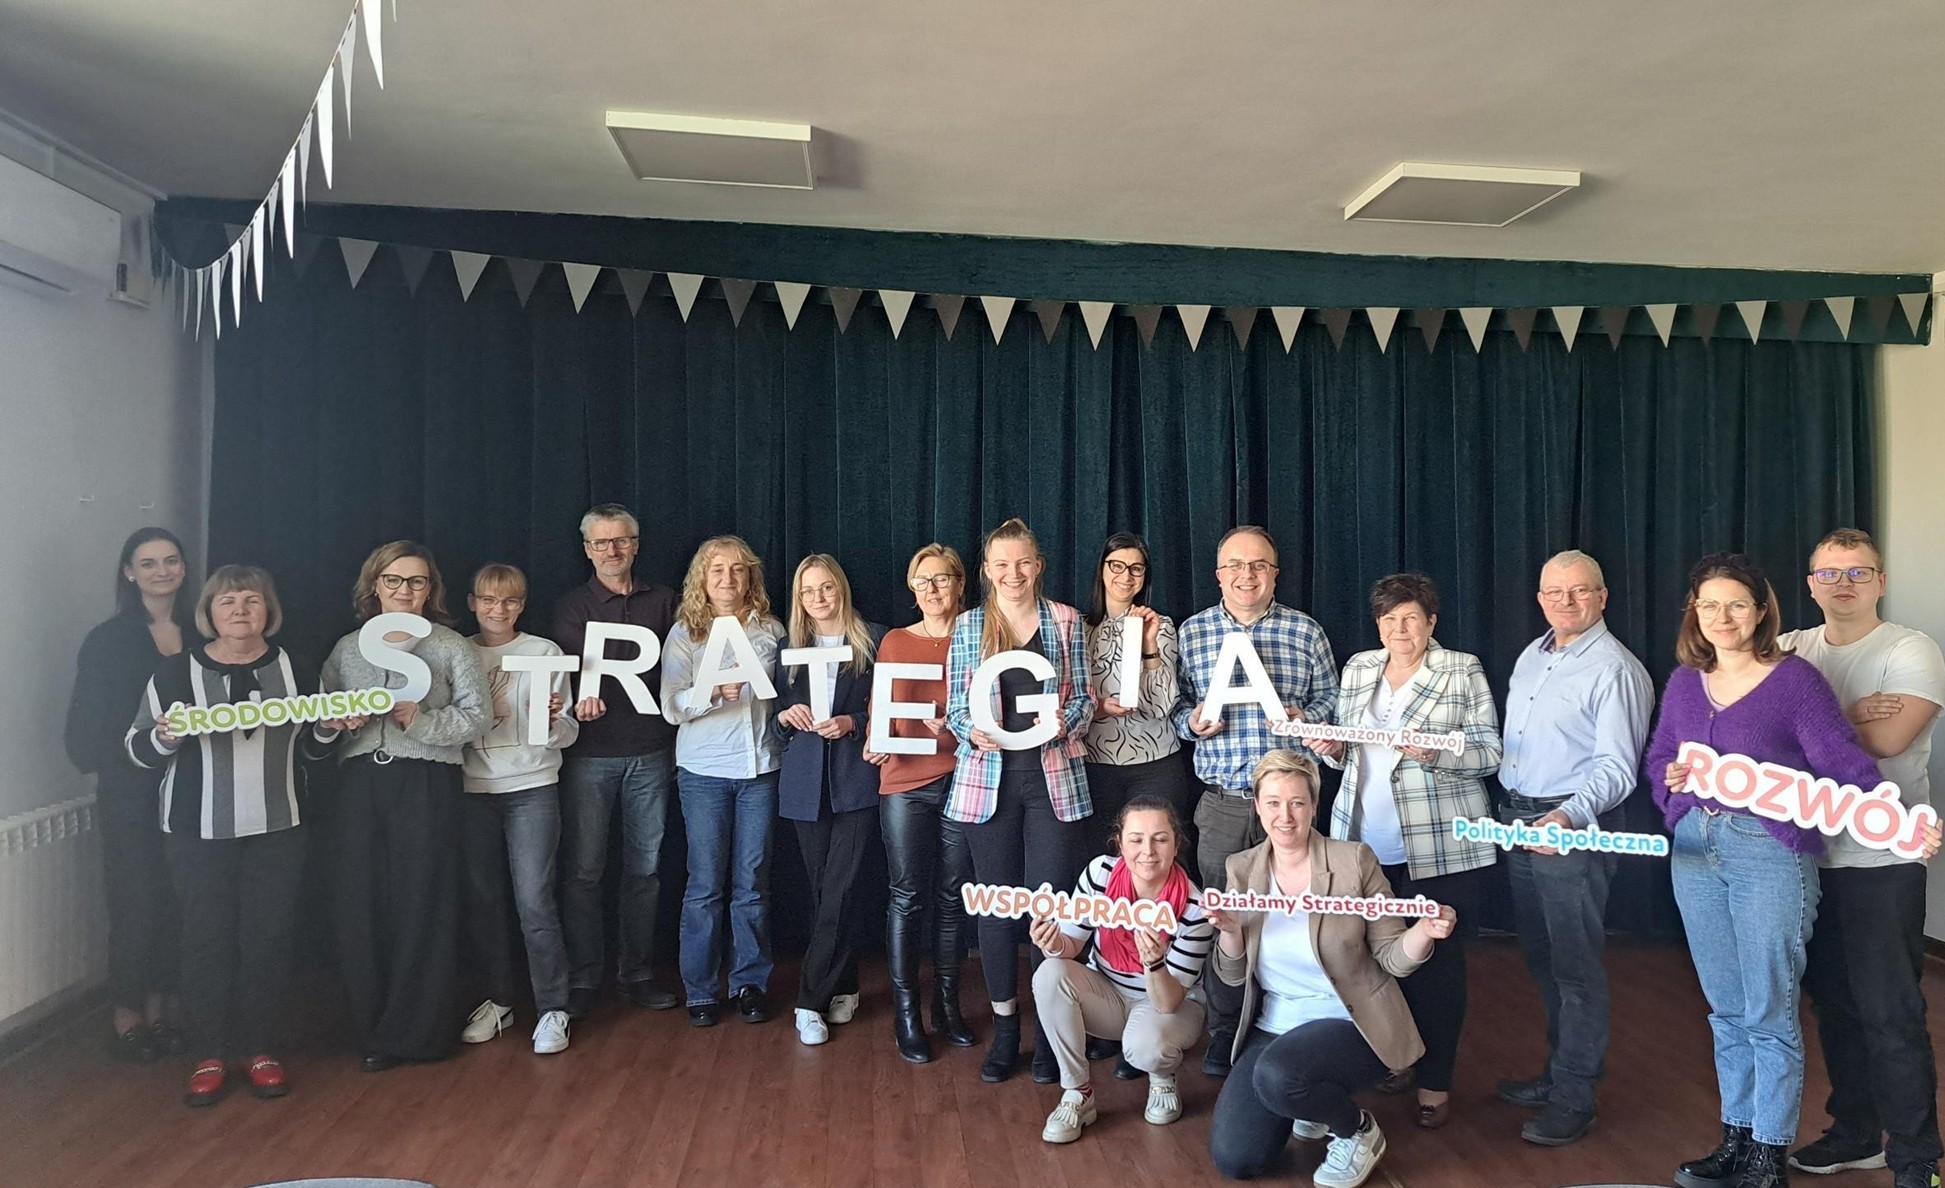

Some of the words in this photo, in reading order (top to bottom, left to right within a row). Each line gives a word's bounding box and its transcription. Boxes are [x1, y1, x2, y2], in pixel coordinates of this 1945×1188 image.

[168, 690, 392, 733] ŚRODOWISKO
[1274, 719, 1396, 746] Zrównoważony
[1401, 729, 1463, 751] Rozwój
[1686, 748, 1929, 852] ROZWÓJ
[1455, 819, 1540, 845] Polityka
[1547, 825, 1665, 853] Społeczna
[965, 886, 1174, 930] WSPÓŁPRACA
[1207, 892, 1297, 914] Działamy
[1302, 894, 1437, 917] Strategicznie
